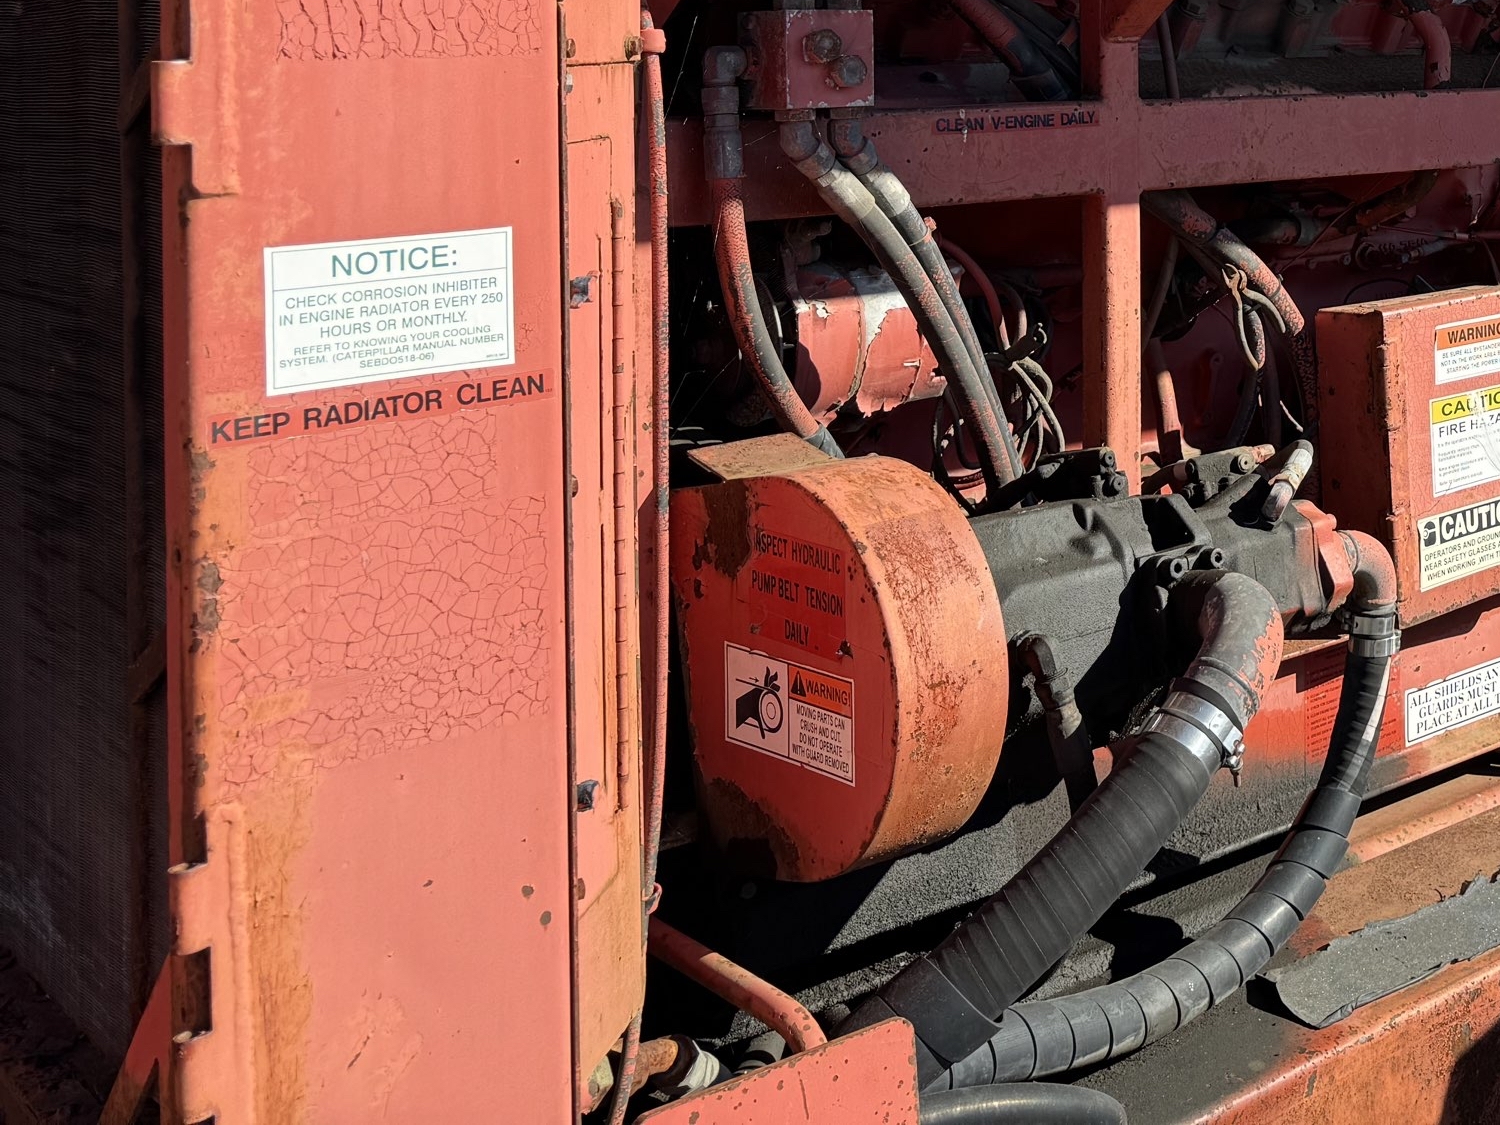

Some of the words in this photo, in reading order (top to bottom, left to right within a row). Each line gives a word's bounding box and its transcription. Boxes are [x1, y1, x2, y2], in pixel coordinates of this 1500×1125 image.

[936, 117, 984, 132] CLEAN
[991, 113, 1055, 129] V-ENGINE
[331, 245, 457, 278] NOTICE:
[285, 293, 337, 309] CHECK
[341, 283, 428, 304] CORROSION
[432, 277, 497, 293] INHIBITER
[279, 314, 293, 326] IN
[299, 307, 354, 324] ENGINE
[360, 300, 429, 318] RADIATOR
[434, 294, 477, 309] EVERY
[481, 292, 503, 304] 250
[320, 321, 371, 338] HOURS
[376, 318, 396, 332] OR
[402, 311, 468, 328] MONTHLY.
[279, 355, 328, 368] SYSTEM.
[332, 344, 409, 363] (CATERPILLAR
[413, 339, 457, 352] MANUAL
[460, 333, 504, 346] NUMBER
[293, 343, 331, 356] REFER
[334, 341, 350, 351] TO
[353, 335, 407, 349] KNOWING
[410, 331, 440, 342] YOUR
[442, 324, 491, 338] COOLING
[1449, 349, 1462, 357] SURE
[1446, 365, 1470, 374] STARTING
[210, 411, 290, 444] KEEP
[303, 388, 442, 430] RADIATOR
[456, 373, 545, 405] CLEAN
[1438, 421, 1466, 438] FIRE
[791, 541, 841, 575] HYDRAULIC
[1423, 559, 1442, 572] WEAR
[1443, 552, 1467, 567] SAFETY
[1467, 542, 1497, 557] GLASSES
[1424, 544, 1462, 562] OPERATORS
[1462, 539, 1476, 549] AND
[1427, 569, 1446, 582] WHEN
[1446, 557, 1476, 574] WORKING
[751, 569, 776, 595] PUMP
[778, 577, 800, 603] BELT
[804, 585, 843, 617] TENSION
[784, 619, 809, 646] DAILY
[805, 678, 851, 707] WARNING!
[1410, 692, 1432, 709] ALL
[1434, 672, 1482, 700] SHIELDS
[1418, 692, 1465, 719] GUARDS
[1467, 680, 1498, 702] MUST
[796, 703, 817, 721] MOVING
[816, 710, 834, 727] PARTS
[834, 717, 845, 731] CAN
[800, 718, 818, 735] CRUSH
[818, 725, 830, 739] AND
[1416, 710, 1453, 735] PLACE
[1455, 705, 1470, 720] AT
[1471, 696, 1493, 714] ALL
[792, 743, 806, 756] WITH
[805, 748, 824, 764] GUARD
[824, 755, 850, 774] REMOVED
[799, 732, 808, 745] DO
[807, 736, 818, 748] NOT
[819, 739, 843, 757] OPERATE
